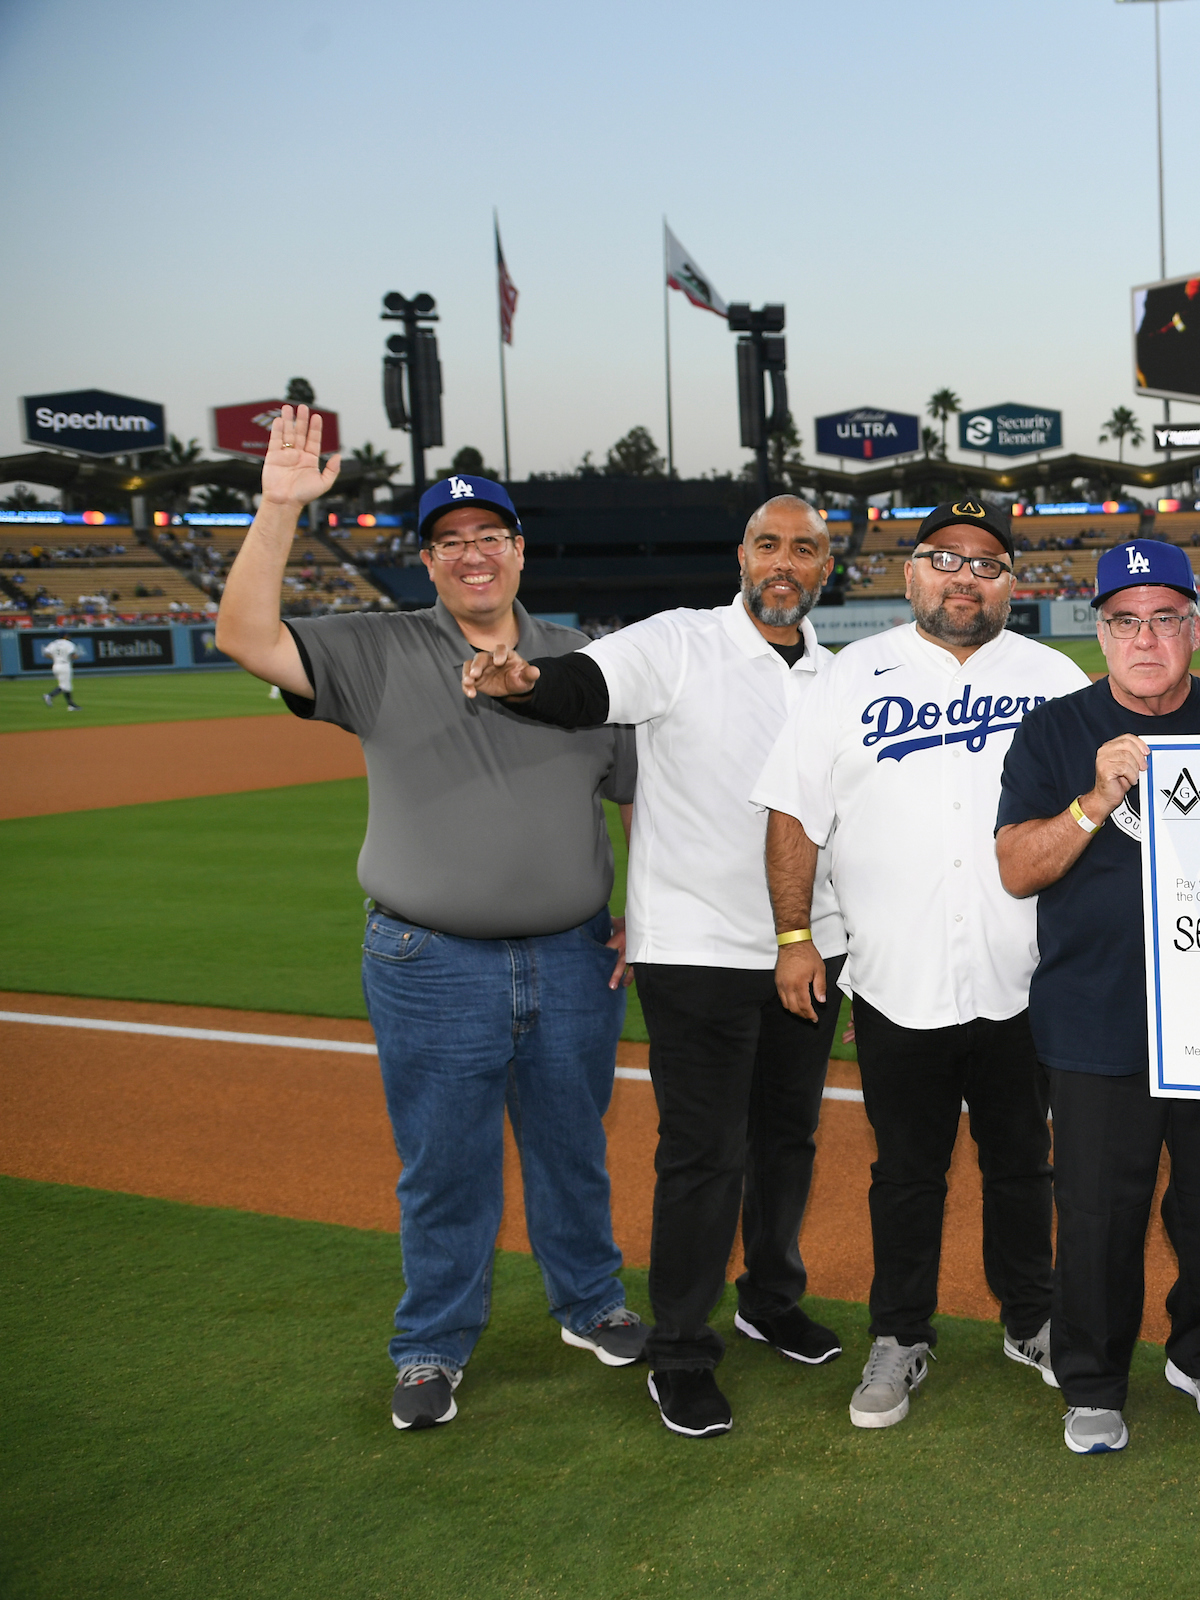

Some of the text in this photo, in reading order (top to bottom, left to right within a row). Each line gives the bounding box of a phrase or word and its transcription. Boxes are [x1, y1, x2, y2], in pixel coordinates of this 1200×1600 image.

[36, 407, 150, 432] Spectrum
[997, 414, 1053, 431] Security
[837, 422, 898, 438] ULTRA
[999, 430, 1046, 445] Benefit
[448, 476, 475, 499] LA
[1126, 546, 1151, 575] LA
[98, 639, 163, 659] Health
[1119, 811, 1141, 834] FOU
[1176, 878, 1196, 891] Pay
[1176, 891, 1195, 902] the
